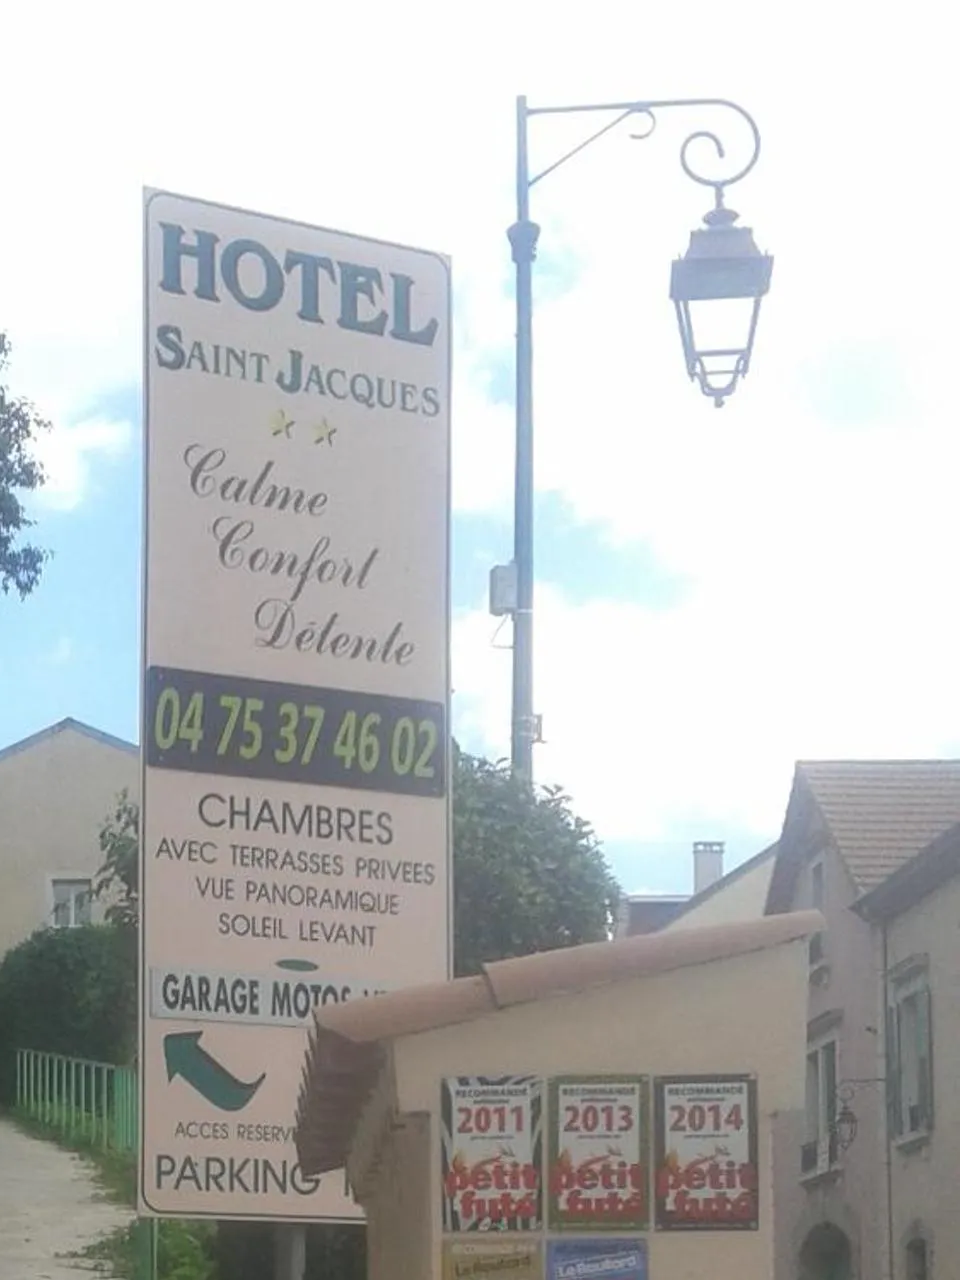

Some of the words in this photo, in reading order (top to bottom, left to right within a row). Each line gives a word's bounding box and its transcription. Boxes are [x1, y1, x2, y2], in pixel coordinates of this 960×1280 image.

[158, 220, 439, 347] HOTEL
[155, 324, 270, 384] SAINT
[275, 348, 441, 418] JACQUES
[184, 443, 328, 516] Calme
[212, 516, 379, 602] Confort
[254, 598, 415, 666] Détente
[154, 685, 205, 753] 04
[216, 695, 263, 760] 75
[274, 701, 325, 766] 37
[333, 709, 381, 774] 46
[390, 716, 438, 779] 02
[197, 793, 394, 846] CHAMBRES
[155, 837, 218, 865] AVEC
[230, 843, 344, 877] TERRASSES
[355, 856, 436, 886] PRIVEES
[195, 875, 235, 901] VUE
[245, 880, 401, 916] PANORAMIQUE
[218, 912, 289, 941] SOLEIL
[298, 919, 377, 948] LEVANT
[161, 973, 261, 1017] GARAGE
[174, 1121, 230, 1141] ACCES
[237, 1123, 297, 1143] RESERV
[457, 1105, 525, 1134] 2011
[563, 1105, 635, 1133] 2013
[669, 1103, 745, 1133] 2014
[156, 1154, 322, 1196] PARKING
